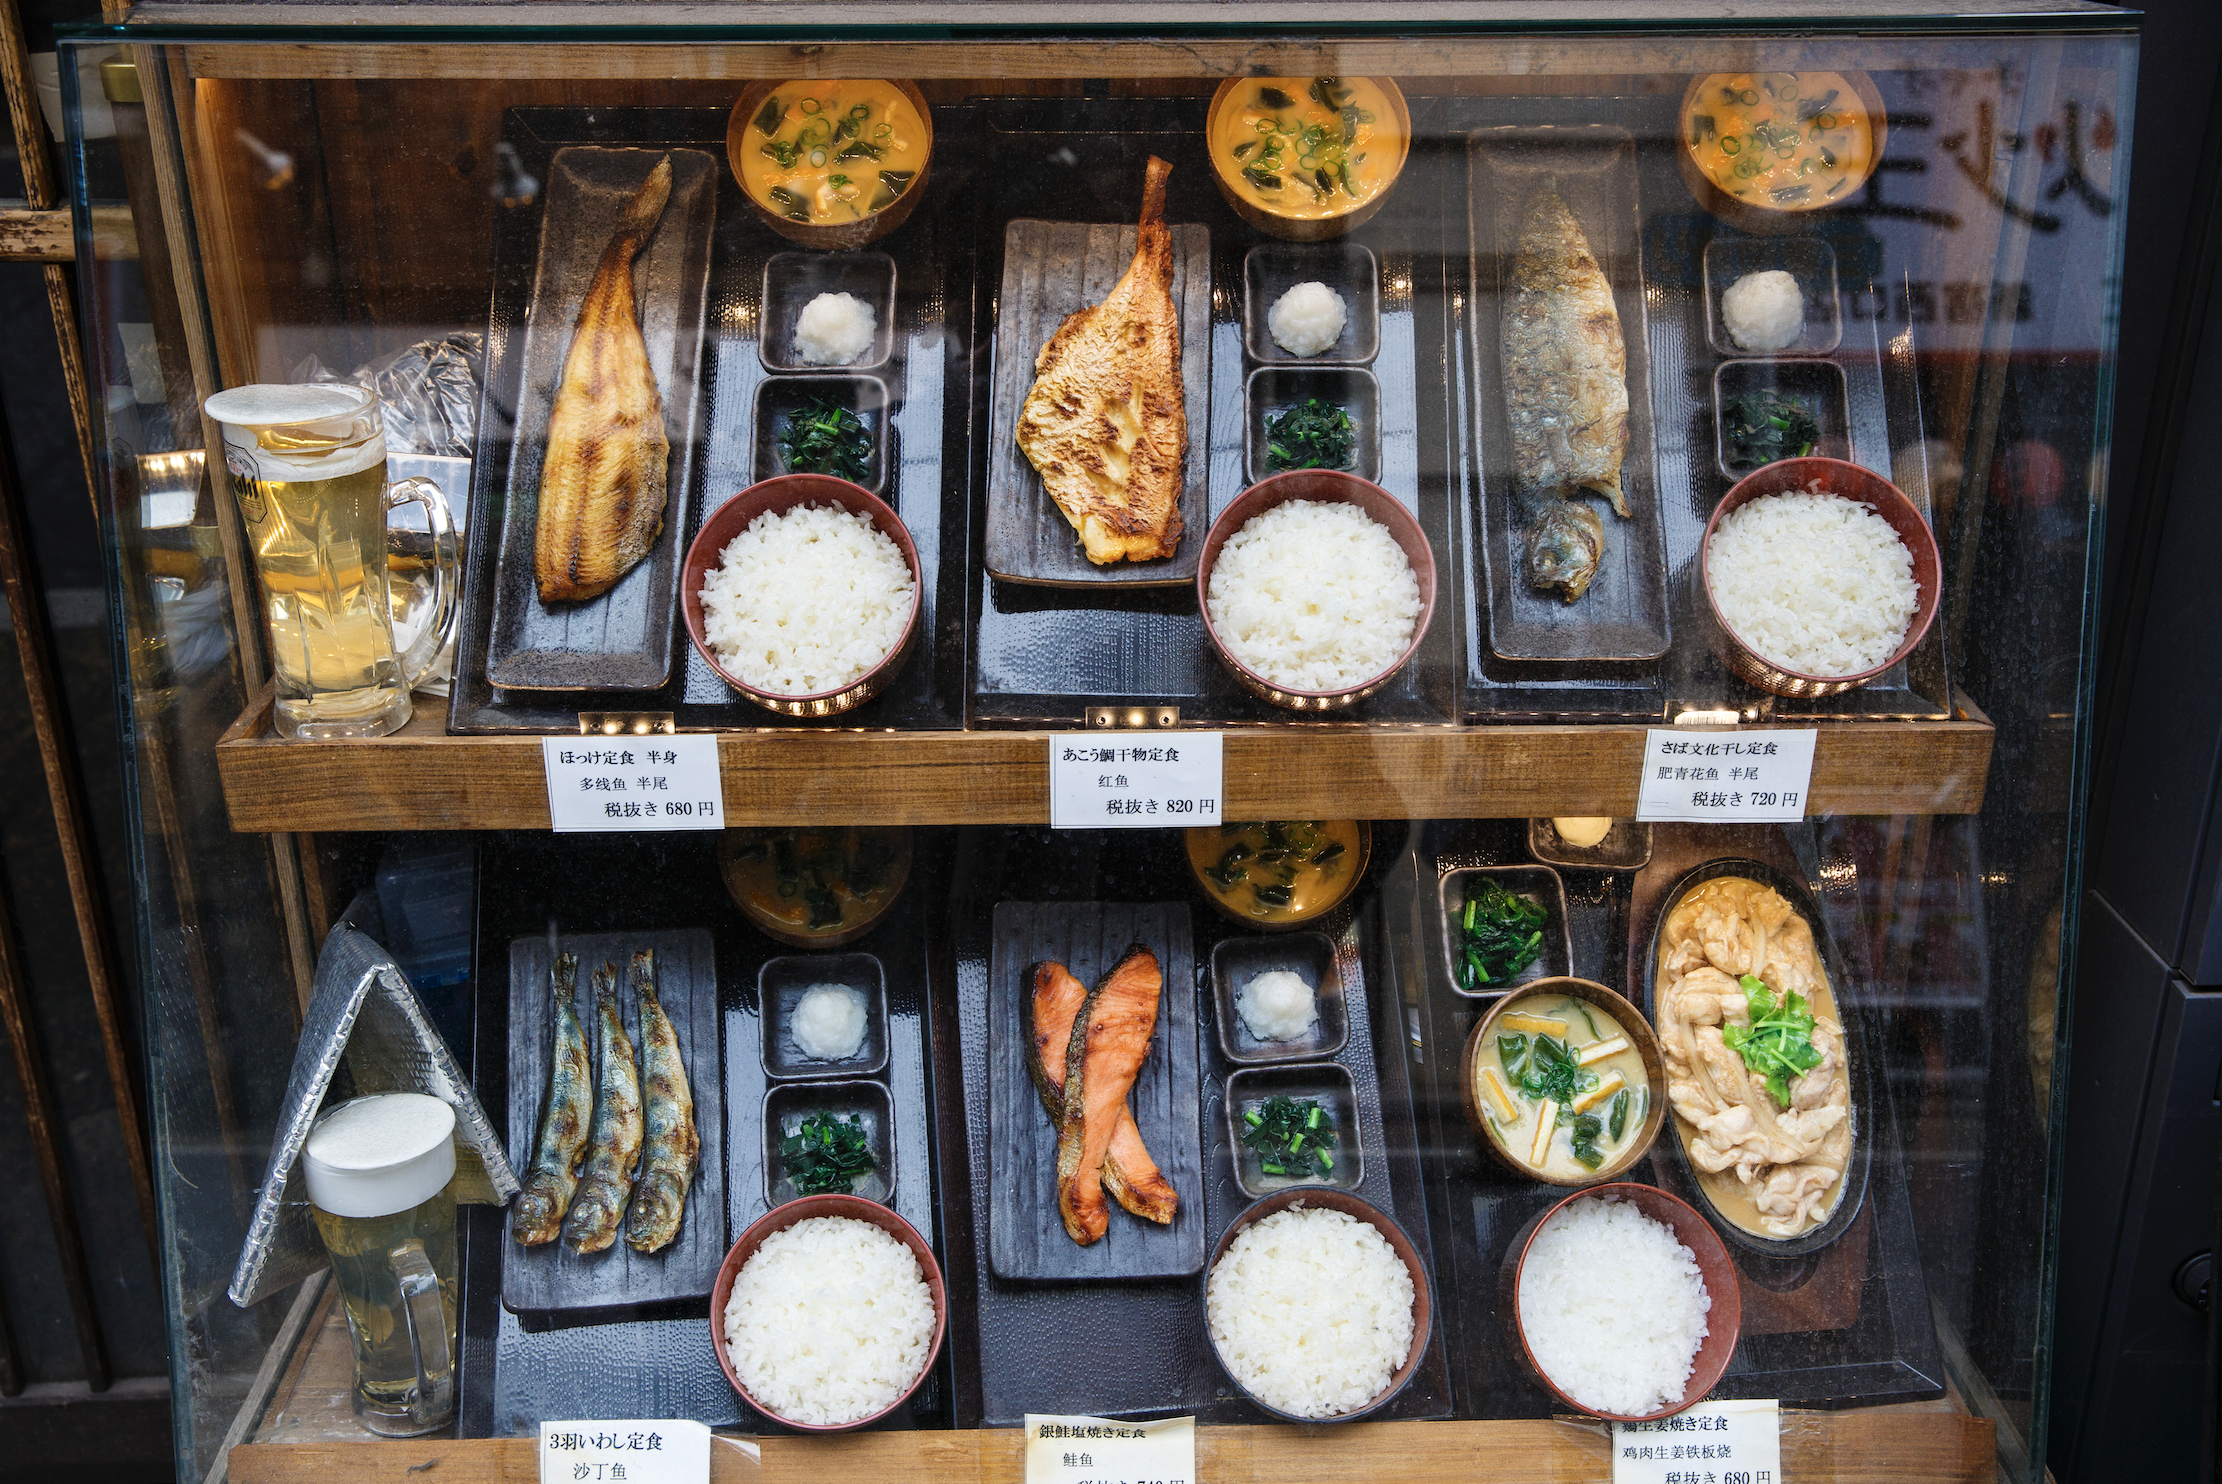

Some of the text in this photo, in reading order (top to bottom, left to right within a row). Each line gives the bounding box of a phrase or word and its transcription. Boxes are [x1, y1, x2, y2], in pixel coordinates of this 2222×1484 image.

[1062, 747, 1180, 762] あこう鯛干物定食
[1661, 741, 1779, 756] さば文化干し定食
[560, 750, 678, 765] ほっけ定食 半身
[1098, 774, 1129, 788] 红鱼
[1656, 766, 1759, 781] 肥青花鱼 半尾
[580, 776, 668, 791] 多线鱼 半尾
[1691, 791, 1798, 807] 税抜き 720 円
[604, 801, 714, 817] 税抜き 680 円
[1105, 799, 1214, 815] 税抜き 820 円
[1039, 1424, 1147, 1439] 銀鮭塩焼き定食
[549, 1432, 663, 1451] 3羽いわし定食
[1622, 1445, 1732, 1460] 鸡肉生姜铁板烧
[573, 1462, 627, 1480] 沙丁鱼
